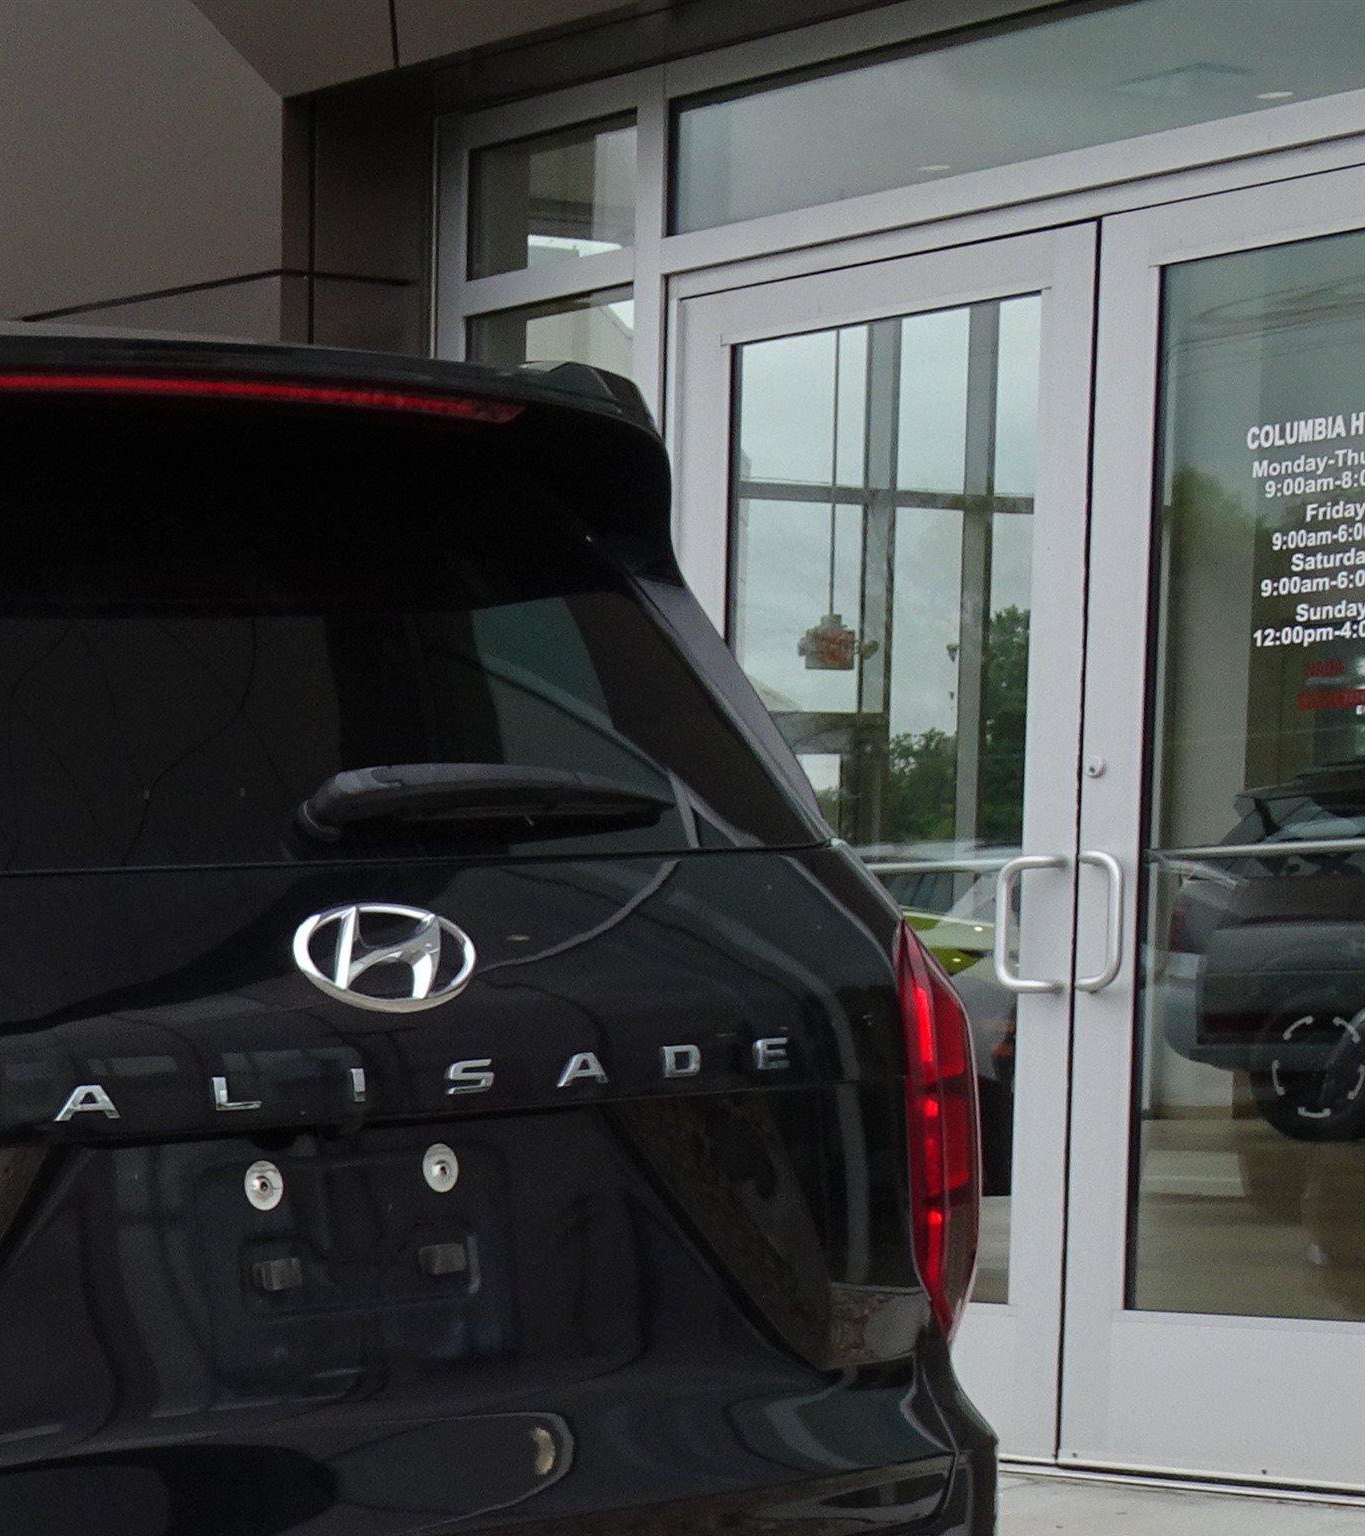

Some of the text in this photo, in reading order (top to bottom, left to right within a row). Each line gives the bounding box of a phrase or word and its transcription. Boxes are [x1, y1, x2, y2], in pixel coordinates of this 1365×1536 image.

[1246, 411, 1365, 450] COLUMBIA H
[1305, 500, 1365, 522] Friday
[1272, 522, 1365, 550] 9:00am-6:0
[1290, 547, 1365, 572] Saturda
[1295, 600, 1365, 622] Sunday
